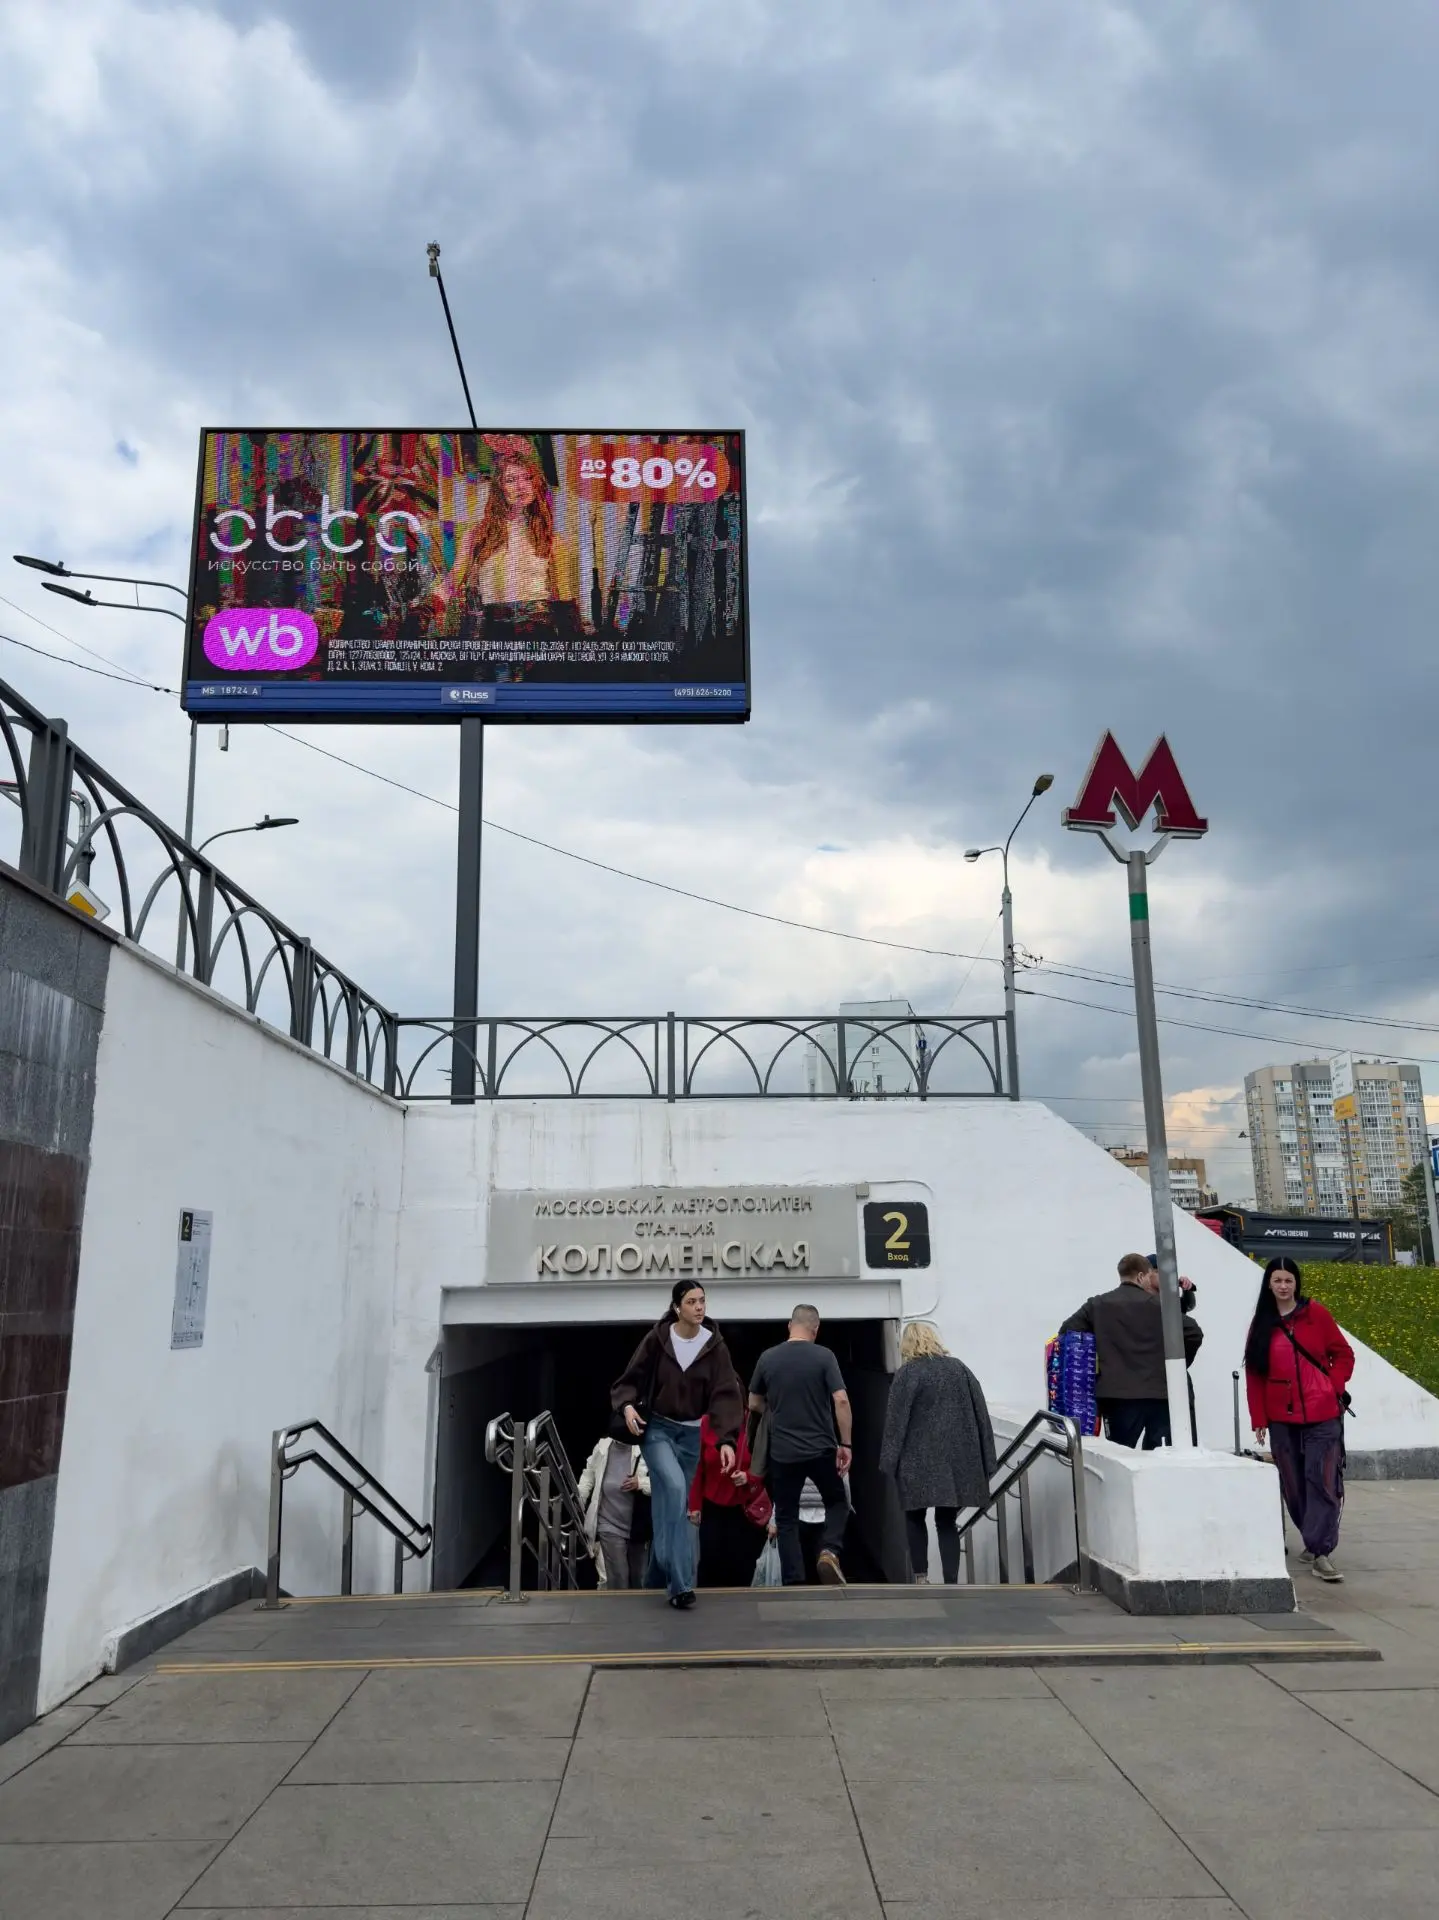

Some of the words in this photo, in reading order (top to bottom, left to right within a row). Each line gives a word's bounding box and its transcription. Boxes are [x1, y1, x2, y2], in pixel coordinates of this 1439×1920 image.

[610, 456, 716, 489] 80%
[208, 558, 304, 575] искусство
[310, 557, 356, 572] быть
[218, 613, 304, 657] wb
[202, 687, 216, 695] MS
[221, 686, 248, 695] 18724
[462, 690, 489, 699] Russ
[695, 688, 732, 696] 626-5200
[535, 1196, 666, 1216] МОСКОВСКИЙ
[672, 1195, 813, 1214] МЕТРОПОЛИТЕН
[634, 1219, 716, 1239] СТАНЦИЯ
[882, 1211, 911, 1249] 2
[536, 1240, 811, 1274] КОЛОМЕНСКАЯ
[887, 1252, 909, 1261] Вход
